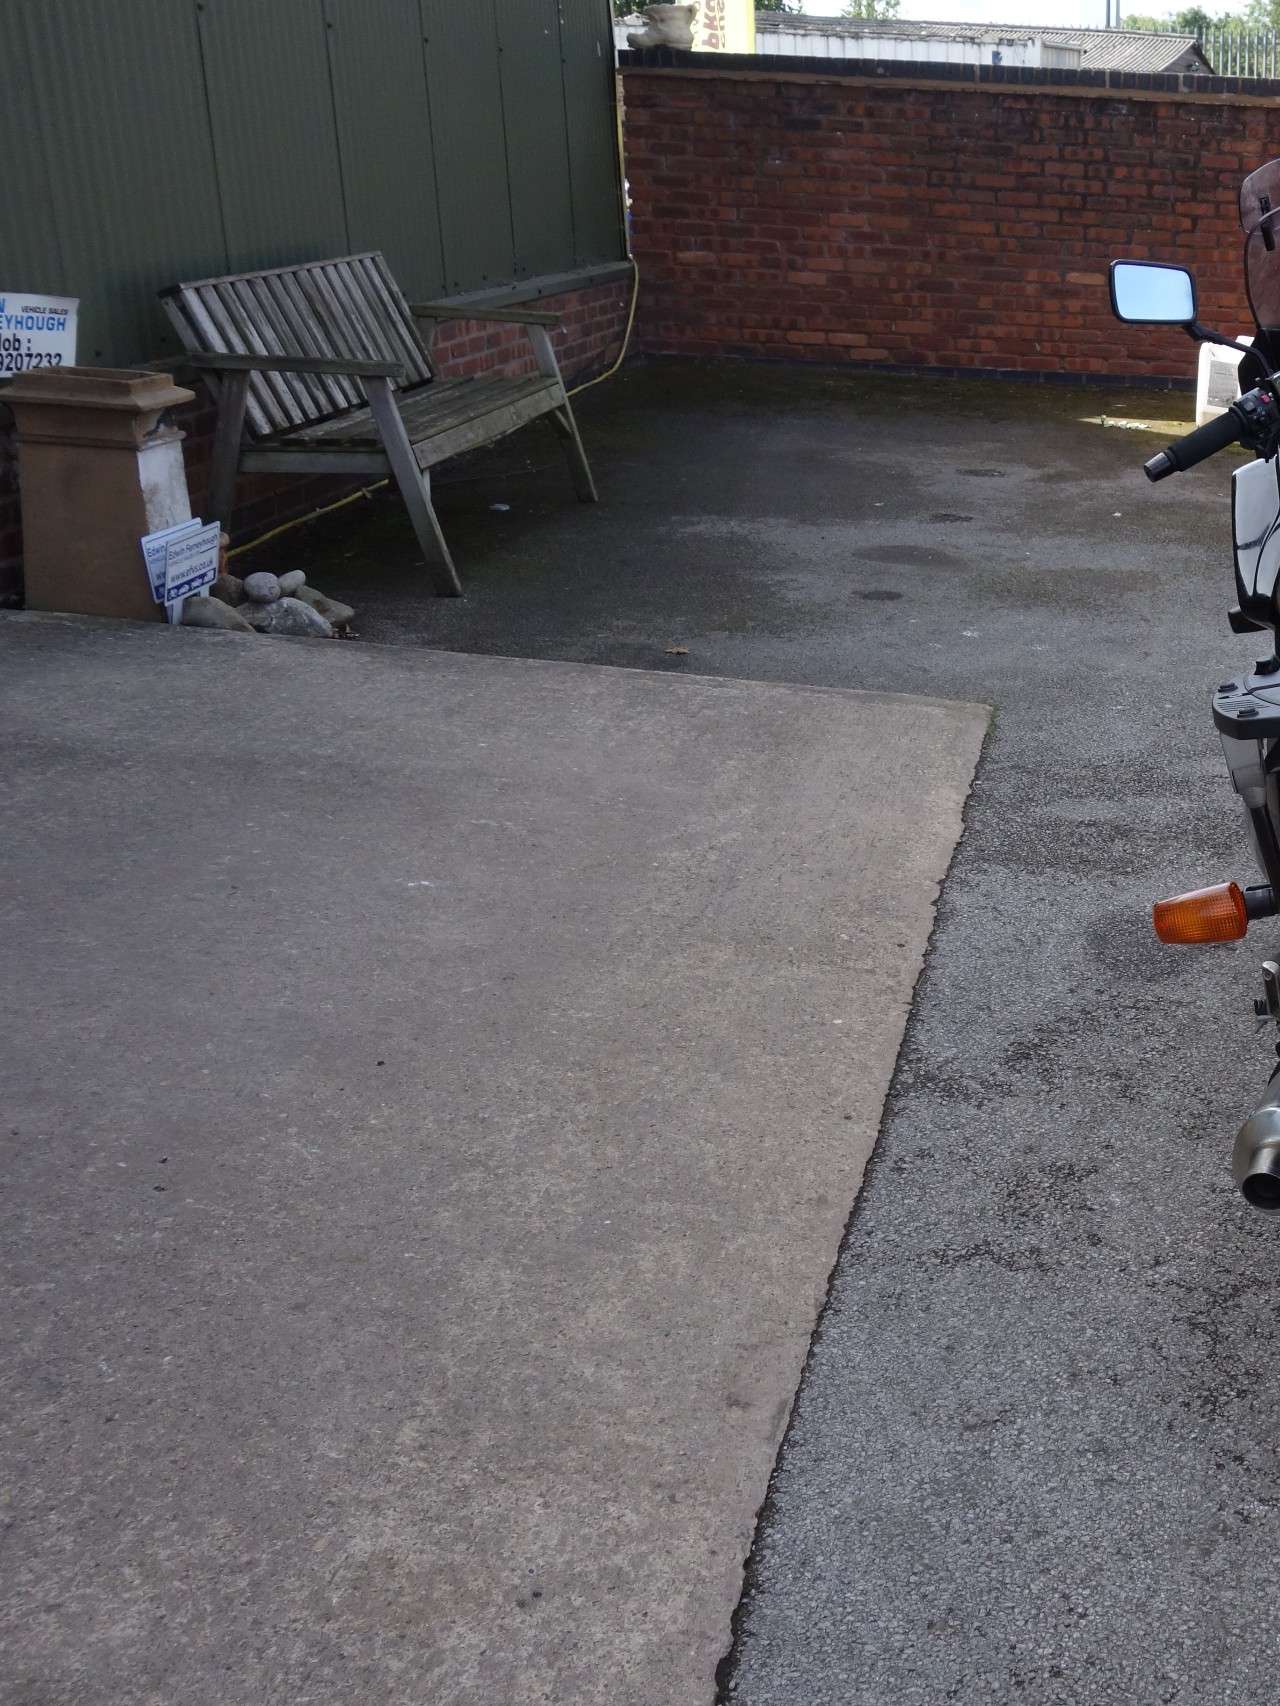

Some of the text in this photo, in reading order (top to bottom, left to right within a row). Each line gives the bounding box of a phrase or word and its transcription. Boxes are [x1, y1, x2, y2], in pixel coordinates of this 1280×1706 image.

[21, 305, 69, 315] VEHICLE SALES
[0, 332, 21, 351] ob
